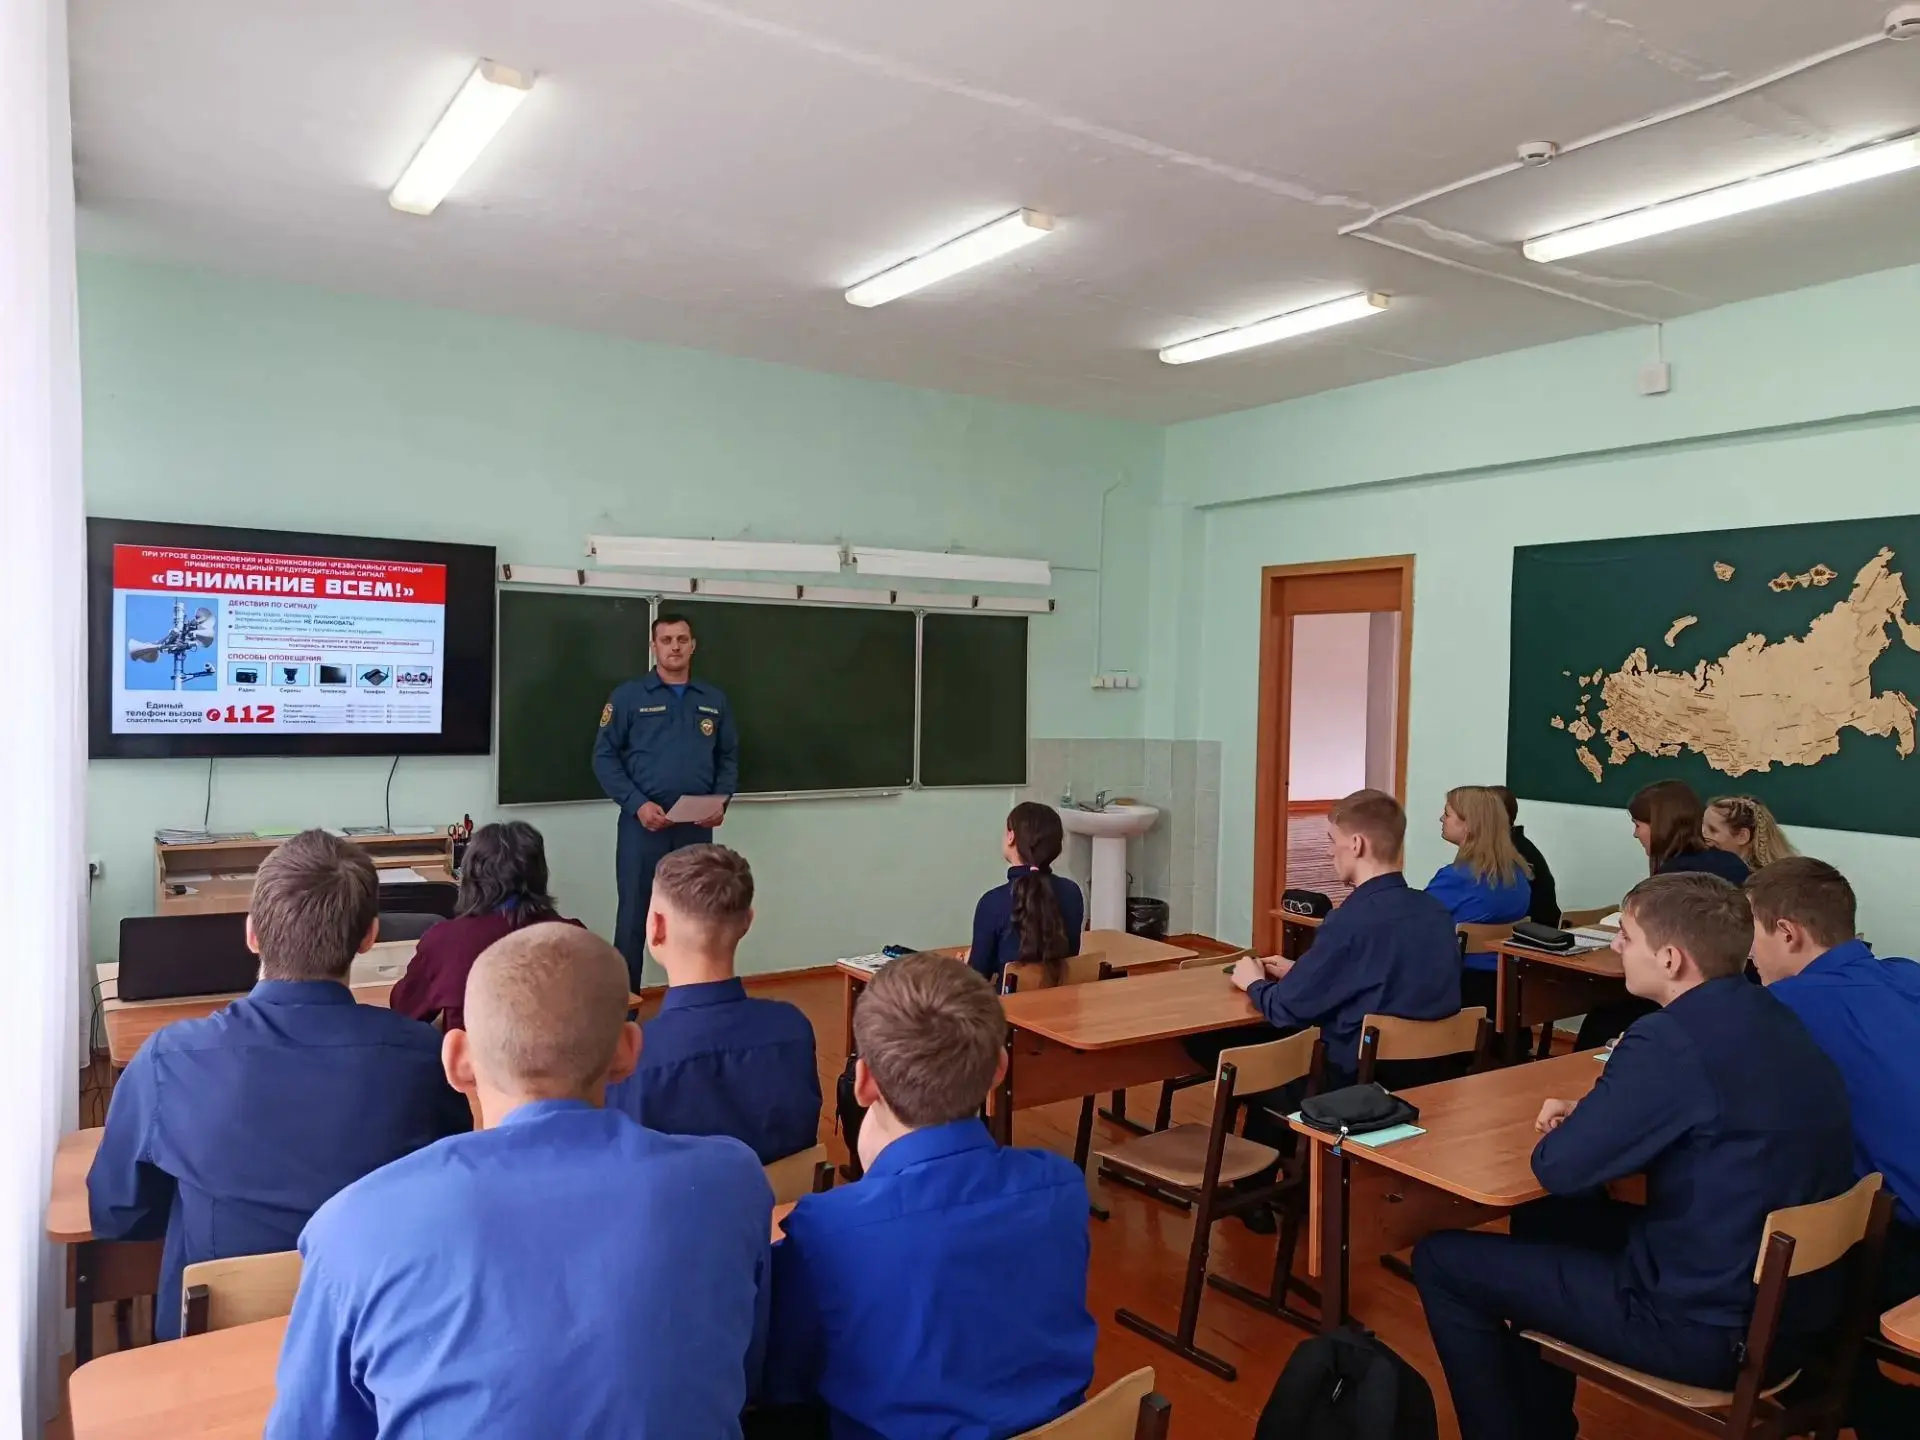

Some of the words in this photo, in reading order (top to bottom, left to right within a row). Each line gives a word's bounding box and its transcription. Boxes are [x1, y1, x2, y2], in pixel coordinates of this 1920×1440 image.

[142, 550, 158, 558] ПРИ
[160, 551, 188, 560] УГРОЗЕ
[190, 553, 256, 563] ВОЗНИКНОВЕНИЯ
[264, 558, 327, 568] ВОЗНИКНОВЕНИИ
[328, 561, 386, 571] ЧРЕЗВЫЧАЙНЫХ
[184, 560, 240, 570] ПРИМЕНЯЕТСЯ
[242, 563, 273, 572] ЕДИНЫЙ
[275, 565, 355, 577] ПРЕДУПРЕДИТЕЛЬНЫЙ
[152, 570, 315, 594] «ВНИМАНИЕ
[325, 579, 414, 598] ВСЕМ!»
[228, 599, 269, 608] ДЕЙСТВИЯ
[283, 602, 317, 610] СИГНАЛУ
[227, 653, 266, 661] СПОСОБЫ
[268, 654, 322, 662] ОПОВЕЩЕНИЯ
[146, 701, 184, 710] Единый
[125, 710, 166, 718] телефон
[223, 705, 275, 723] 112
[179, 716, 203, 724] служб
